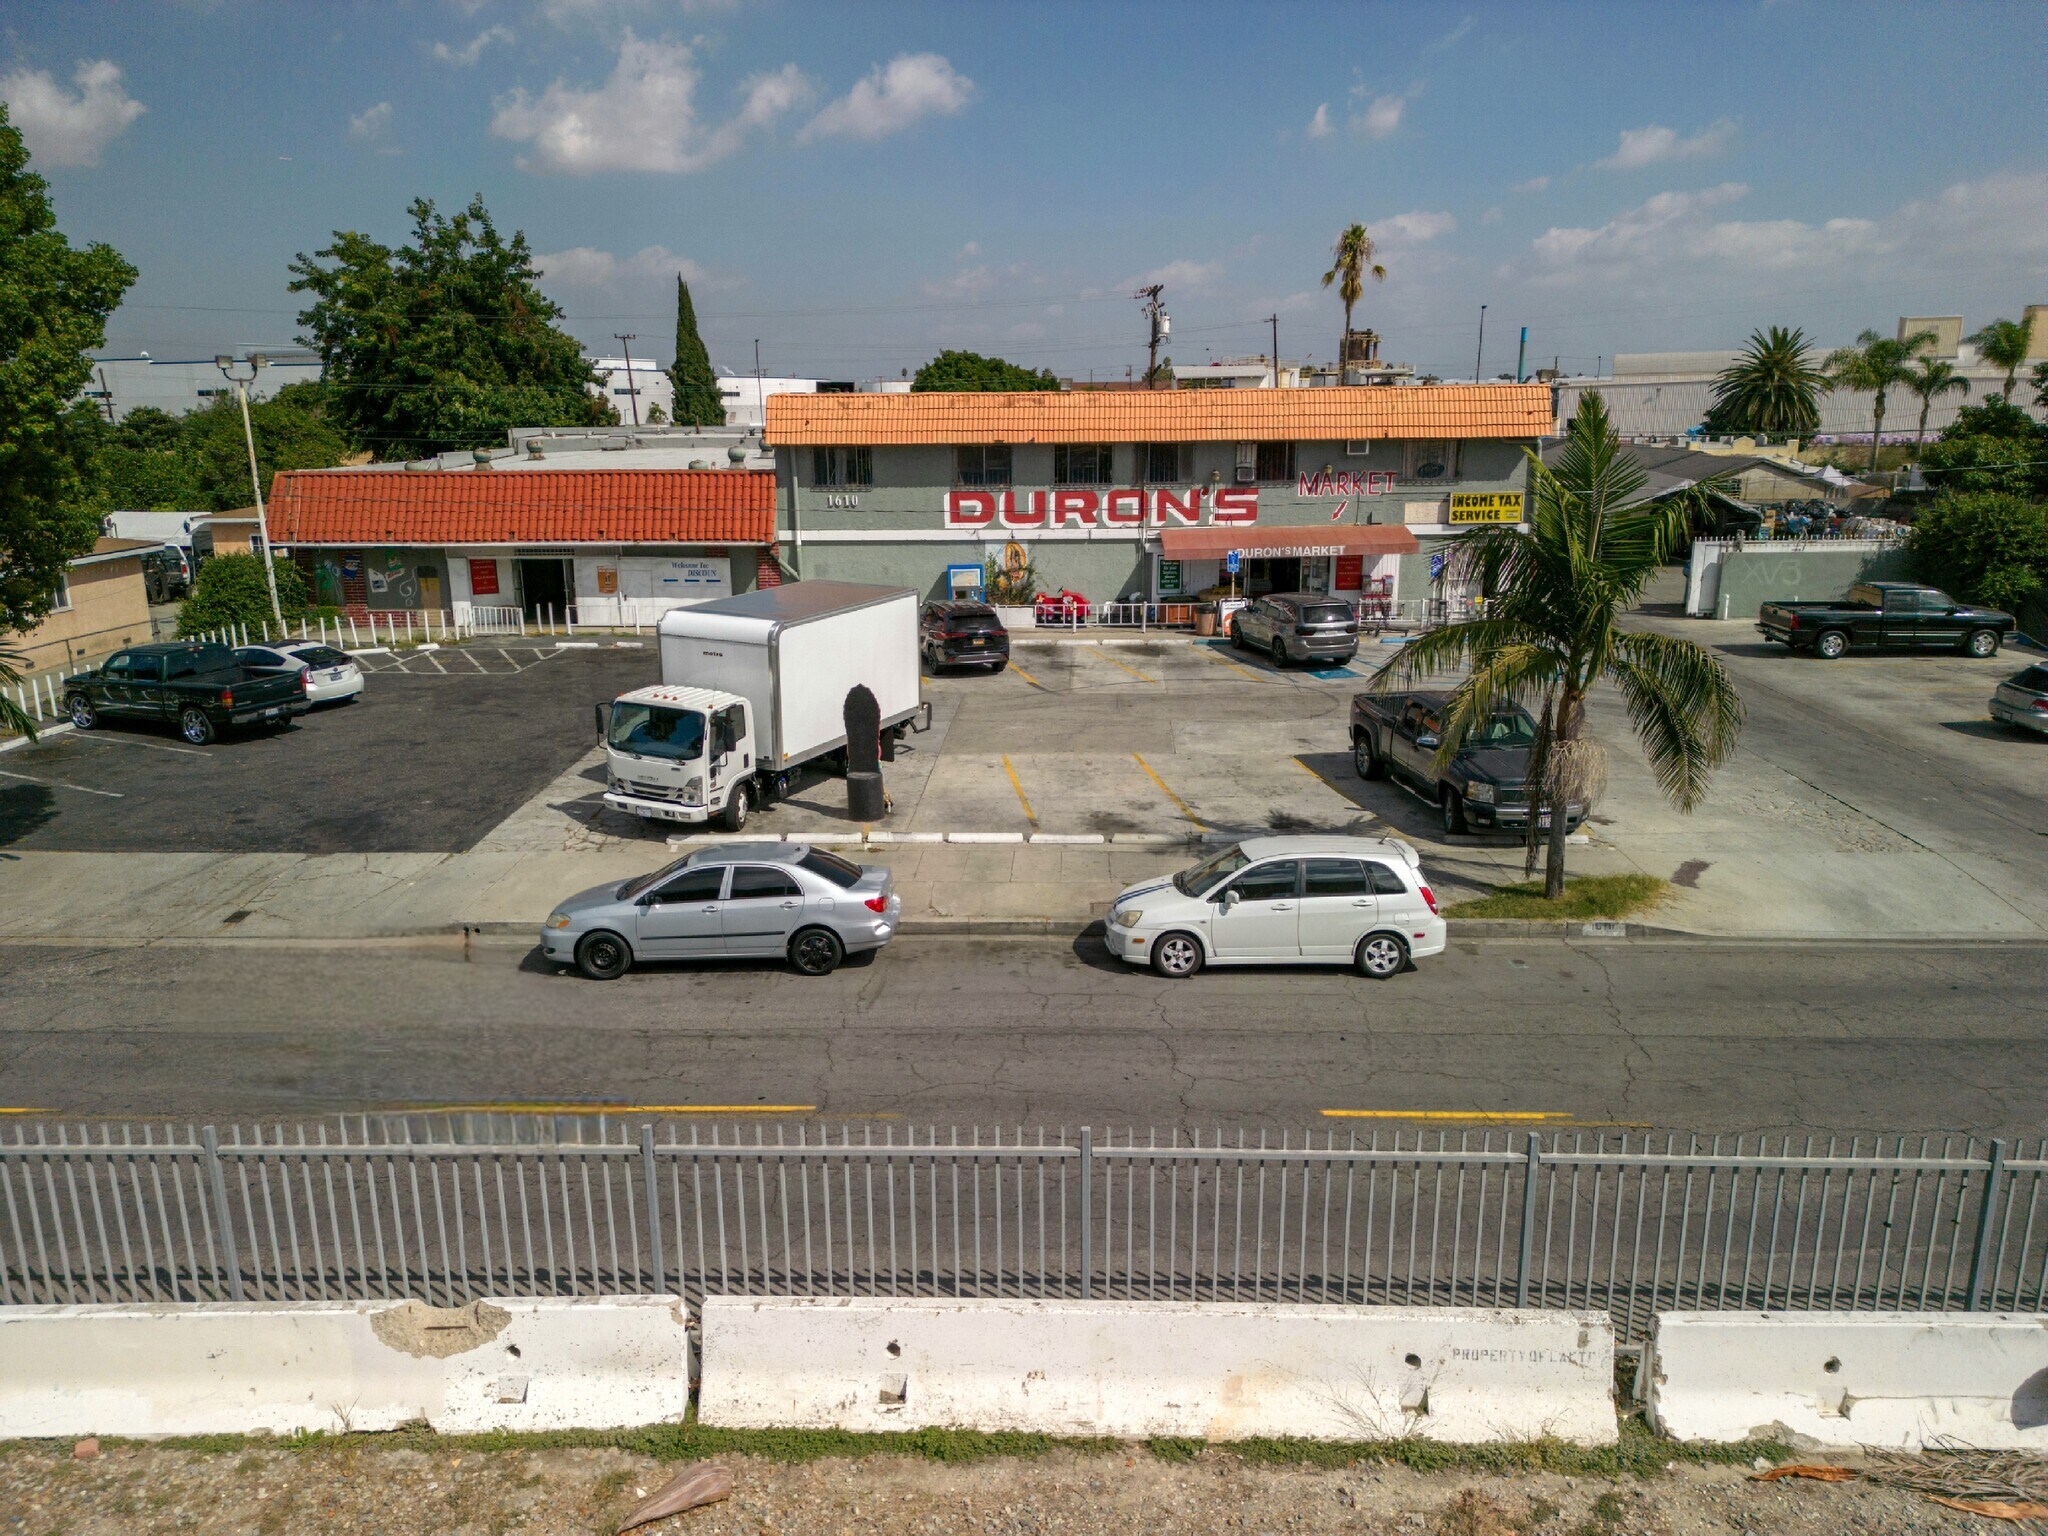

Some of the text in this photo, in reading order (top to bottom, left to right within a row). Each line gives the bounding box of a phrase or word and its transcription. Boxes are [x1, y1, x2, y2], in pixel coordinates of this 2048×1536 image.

[1298, 470, 1398, 497] MARKET
[827, 494, 859, 510] 1610
[943, 487, 1260, 529] DURON'S
[1452, 494, 1521, 508] INCOME TAX
[1452, 509, 1501, 521] SERVICE
[1237, 545, 1347, 559] DURON'S MARKET
[1452, 1348, 1524, 1362] PROPERTY
[1529, 1349, 1546, 1363] OF
